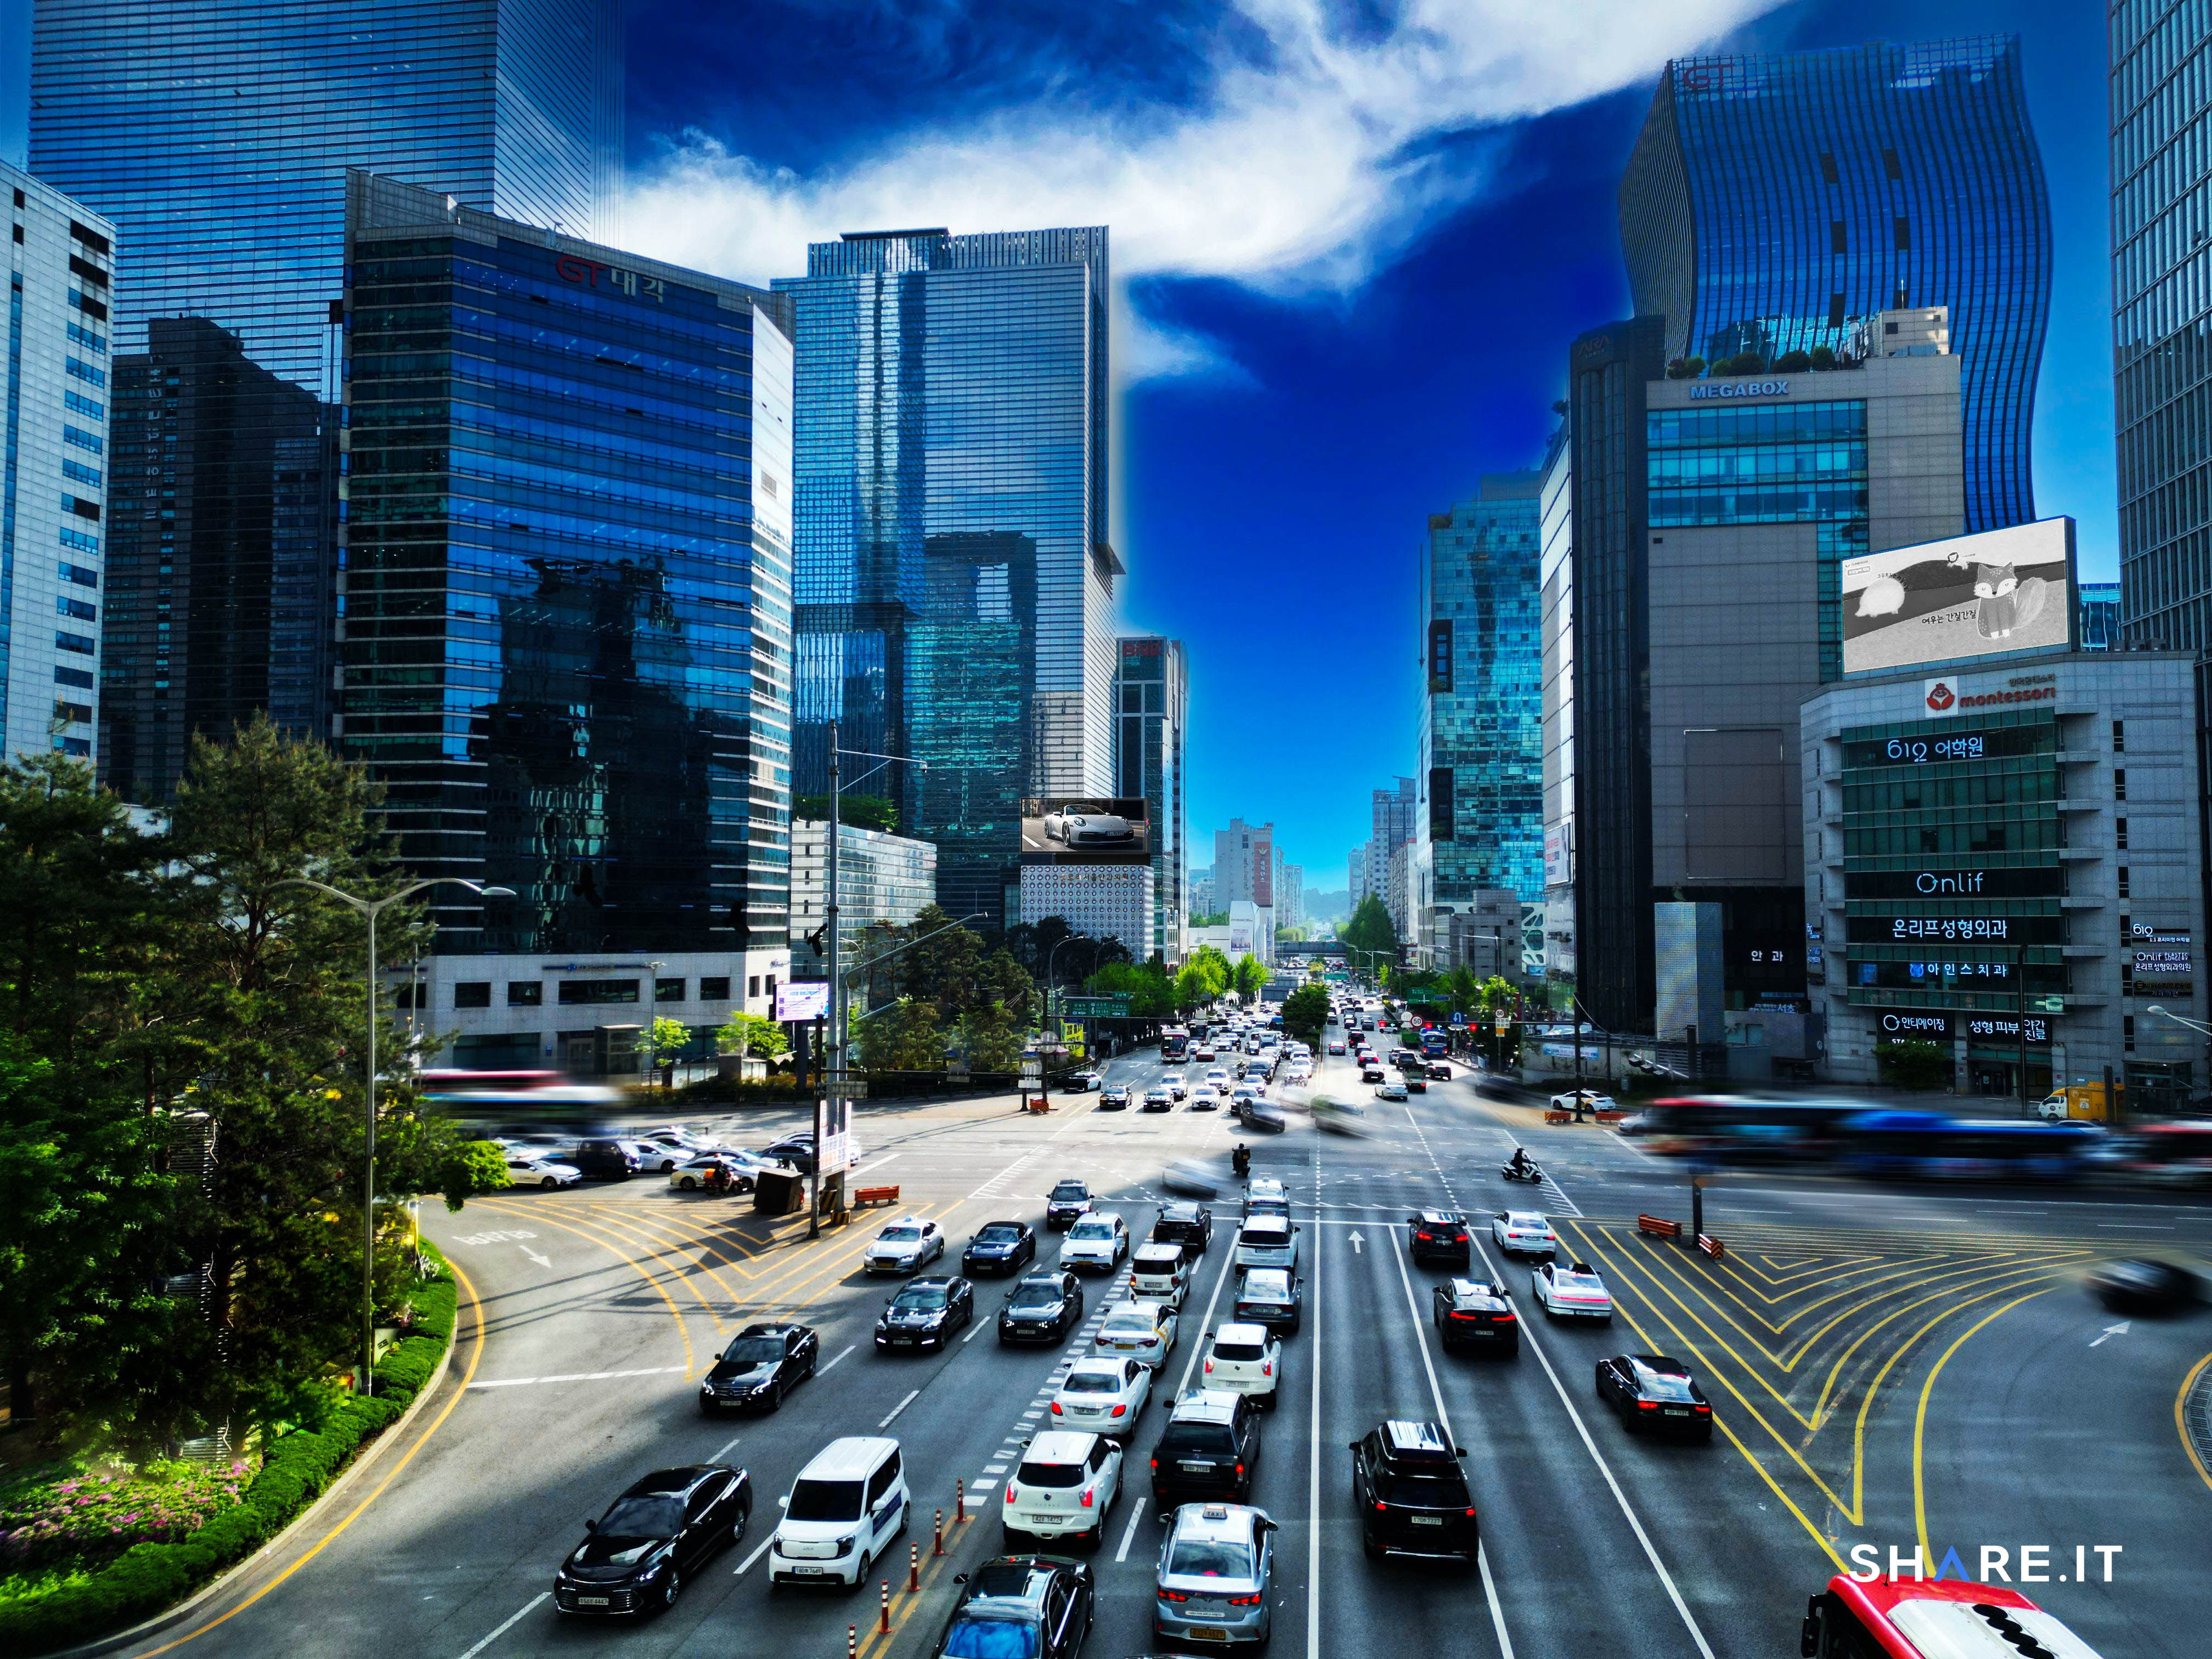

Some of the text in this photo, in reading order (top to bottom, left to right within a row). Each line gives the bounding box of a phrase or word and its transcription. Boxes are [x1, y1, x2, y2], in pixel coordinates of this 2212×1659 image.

[556, 255, 666, 303] GT 대각
[1690, 381, 1788, 399] MEGABOX
[1921, 609, 1976, 624] 여우는 간질간질
[1959, 687, 2056, 708] montessori
[1935, 736, 1983, 759] 어학원
[1917, 872, 1983, 893] Onlif
[1893, 919, 2007, 939] 온리프성형외과
[2133, 924, 2153, 937] 612
[2137, 952, 2162, 961] Onlif
[2135, 963, 2191, 972] 온리프성형외과의원
[1901, 1017, 1944, 1031] 안티에이징
[1970, 1020, 2020, 1034] 성형 피부
[2024, 1019, 2046, 1031] 야간
[2024, 1030, 2046, 1041] 진료
